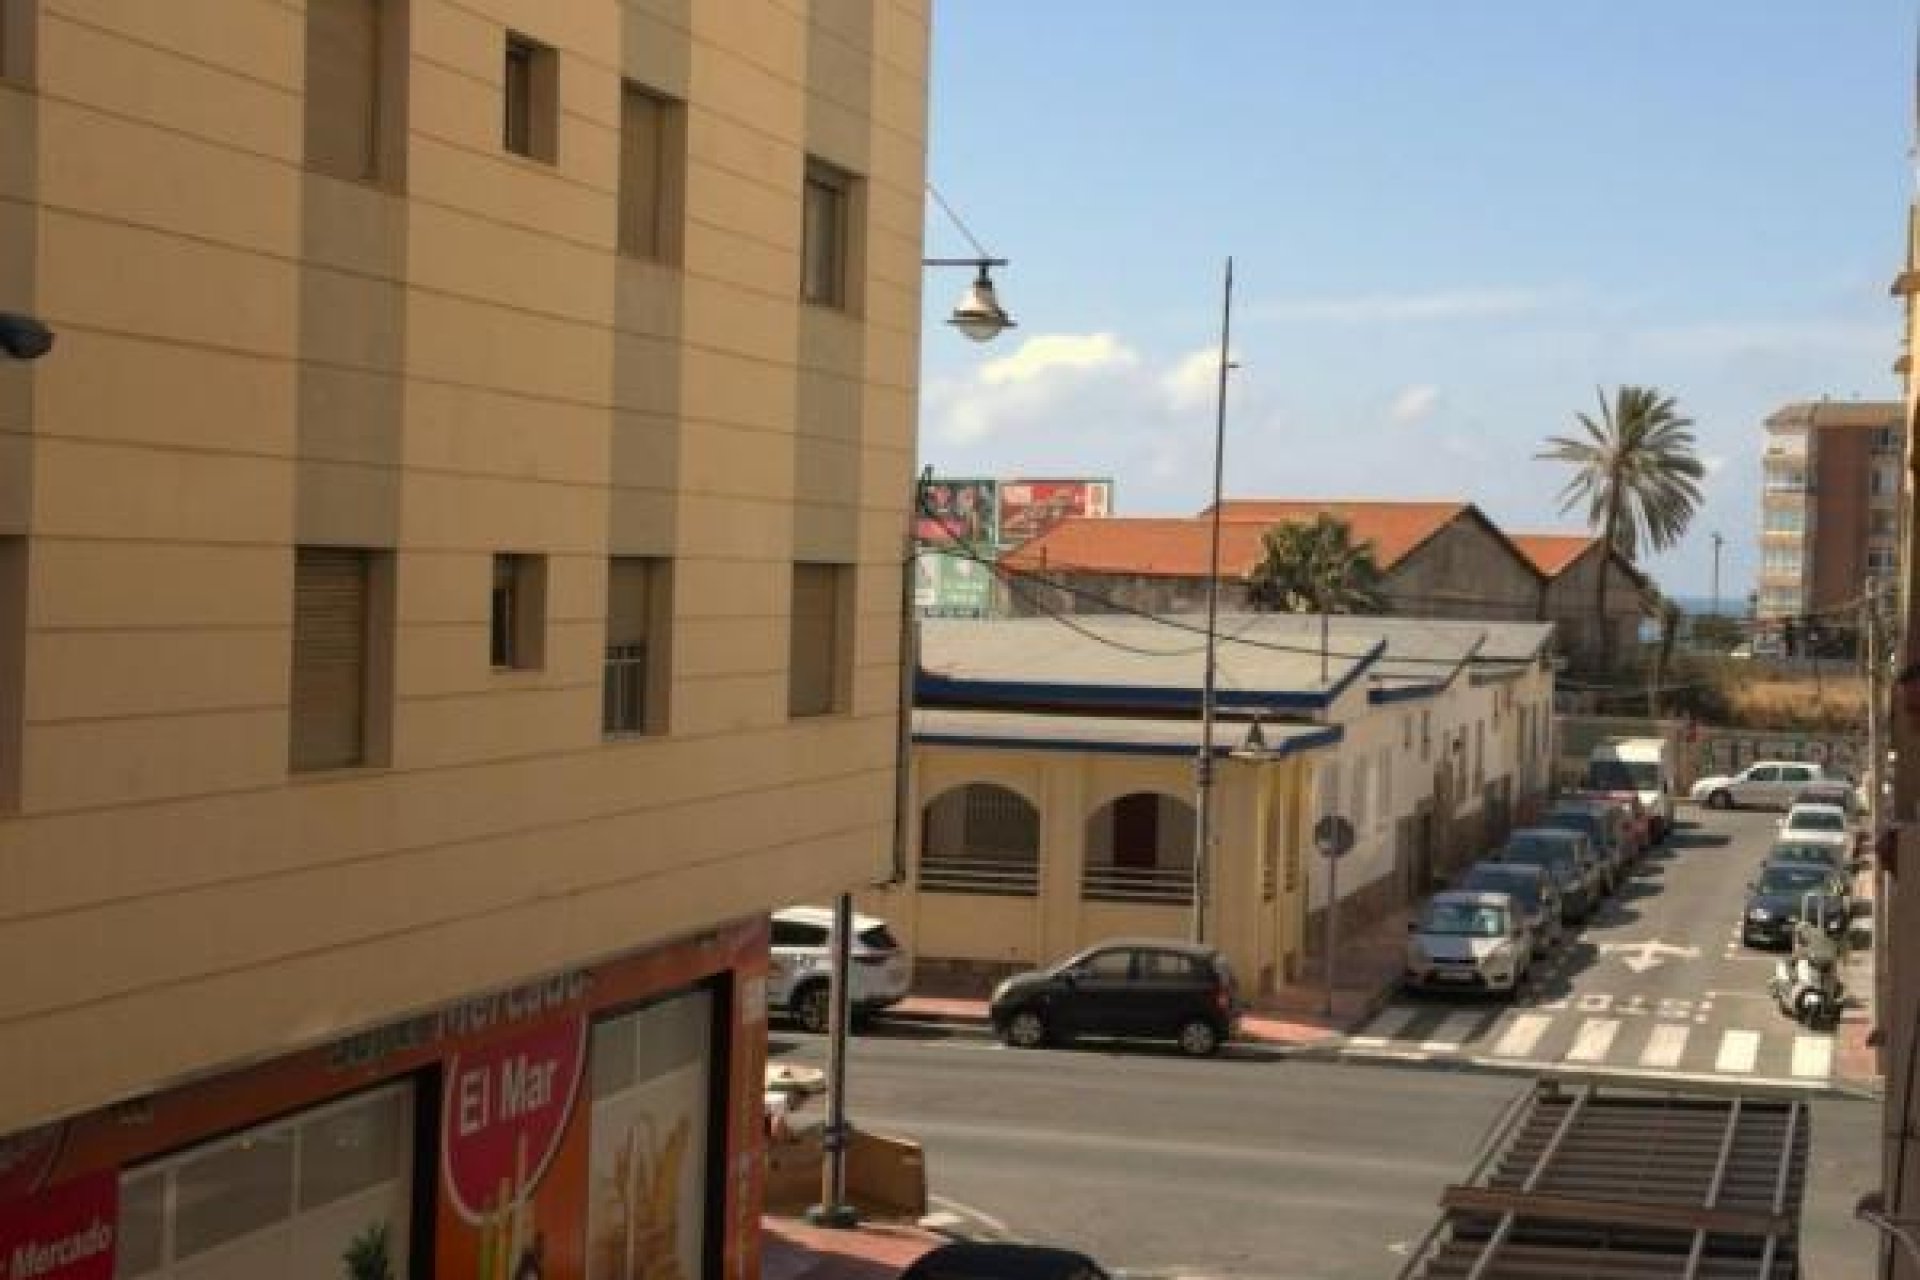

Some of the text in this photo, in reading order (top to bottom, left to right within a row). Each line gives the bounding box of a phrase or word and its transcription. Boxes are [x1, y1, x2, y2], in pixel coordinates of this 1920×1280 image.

[461, 1052, 560, 1137] El Mar
[11, 1214, 113, 1280] Mercado
